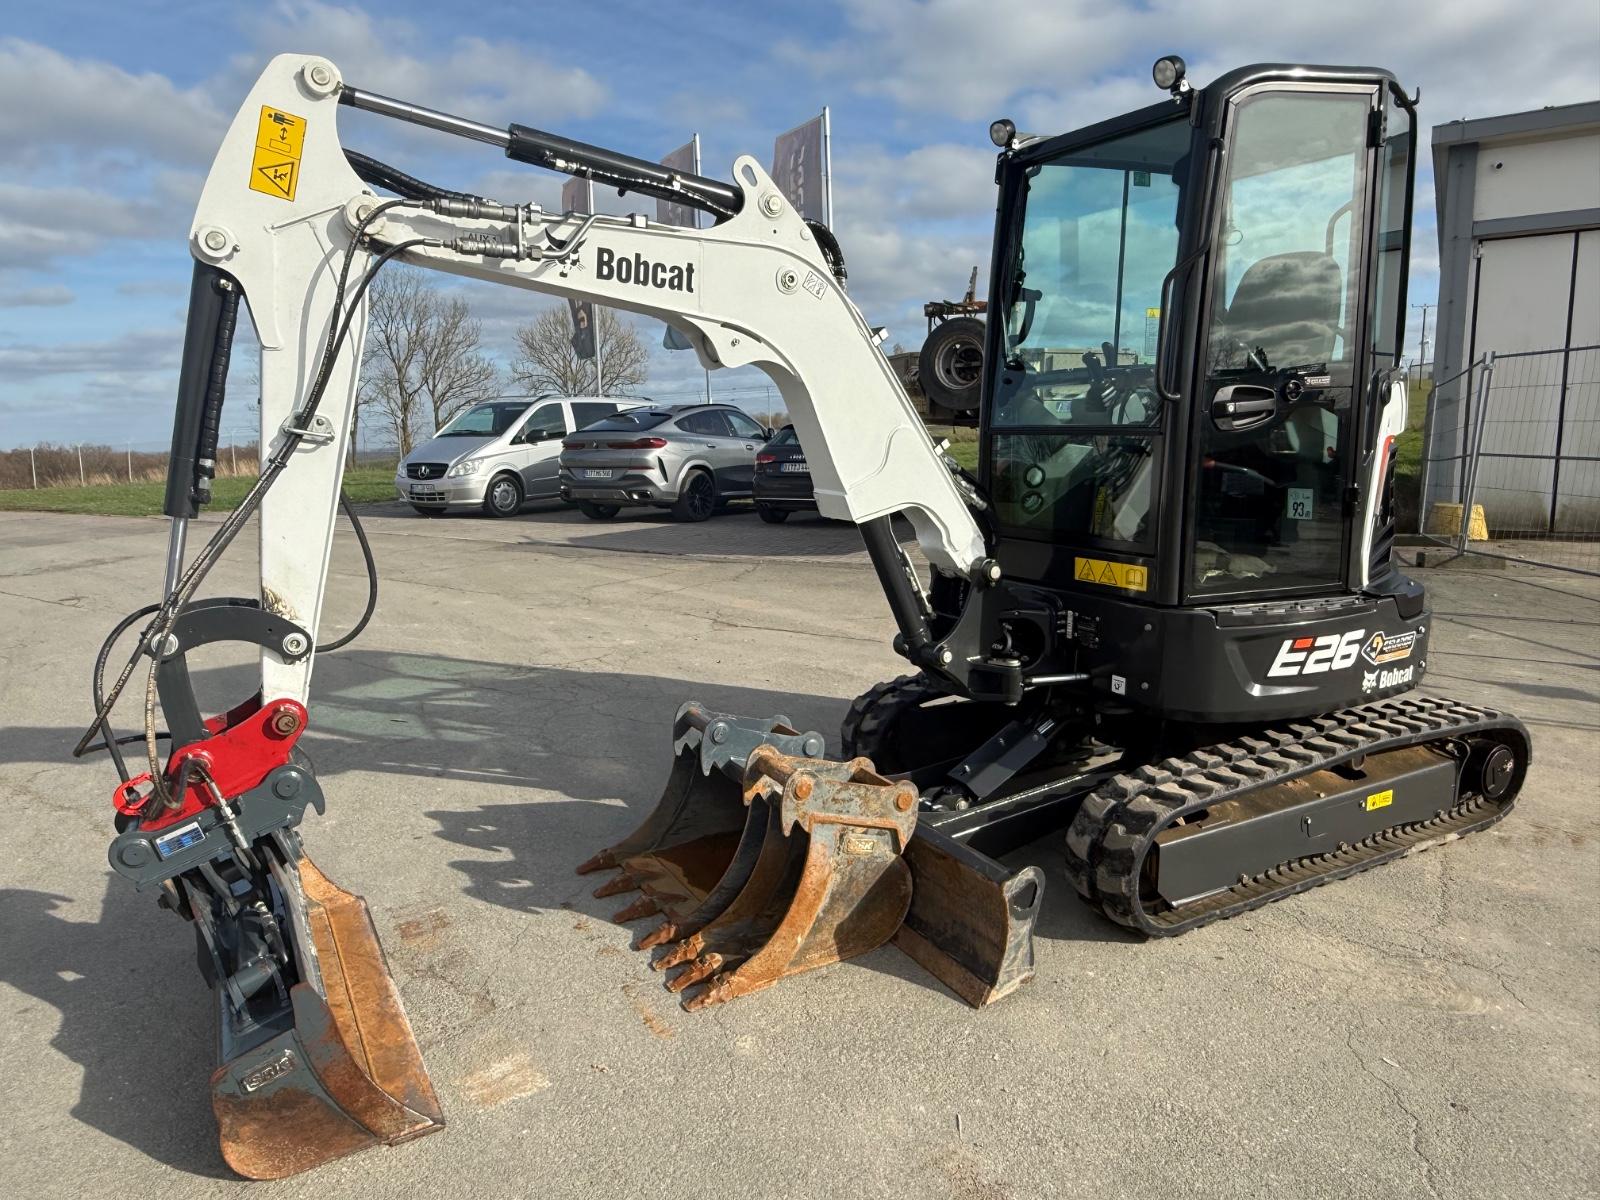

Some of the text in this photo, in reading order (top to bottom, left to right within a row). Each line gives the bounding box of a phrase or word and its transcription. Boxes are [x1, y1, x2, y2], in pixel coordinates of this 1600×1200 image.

[596, 246, 695, 293] Bobcat
[1292, 501, 1305, 517] 93
[1267, 629, 1366, 677] E26
[1378, 665, 1414, 689] Bobcat
